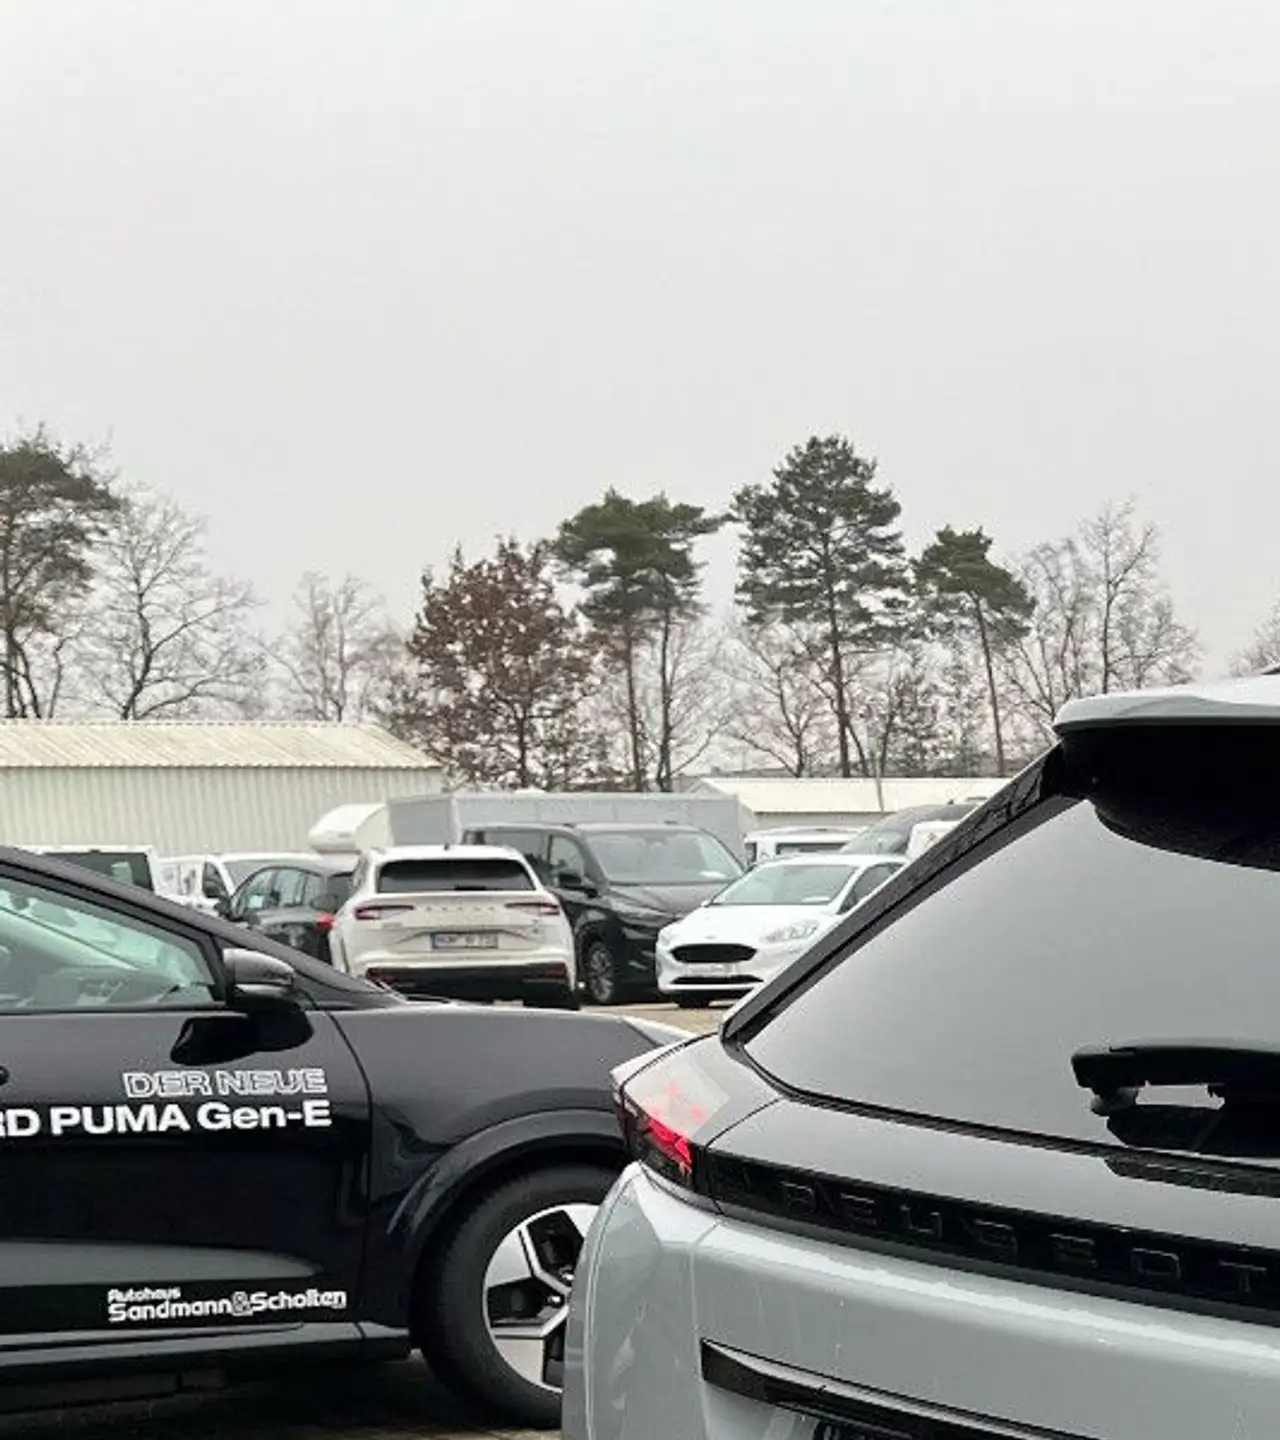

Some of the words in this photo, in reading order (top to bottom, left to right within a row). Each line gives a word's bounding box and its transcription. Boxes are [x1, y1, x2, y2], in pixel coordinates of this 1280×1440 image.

[122, 1071, 213, 1098] DER
[216, 1067, 329, 1096] NEUE
[50, 1104, 191, 1136] PUMA
[196, 1099, 333, 1132] Gen-E
[779, 1179, 1268, 1294] PEUGEOT
[107, 1286, 182, 1304] Autohaus
